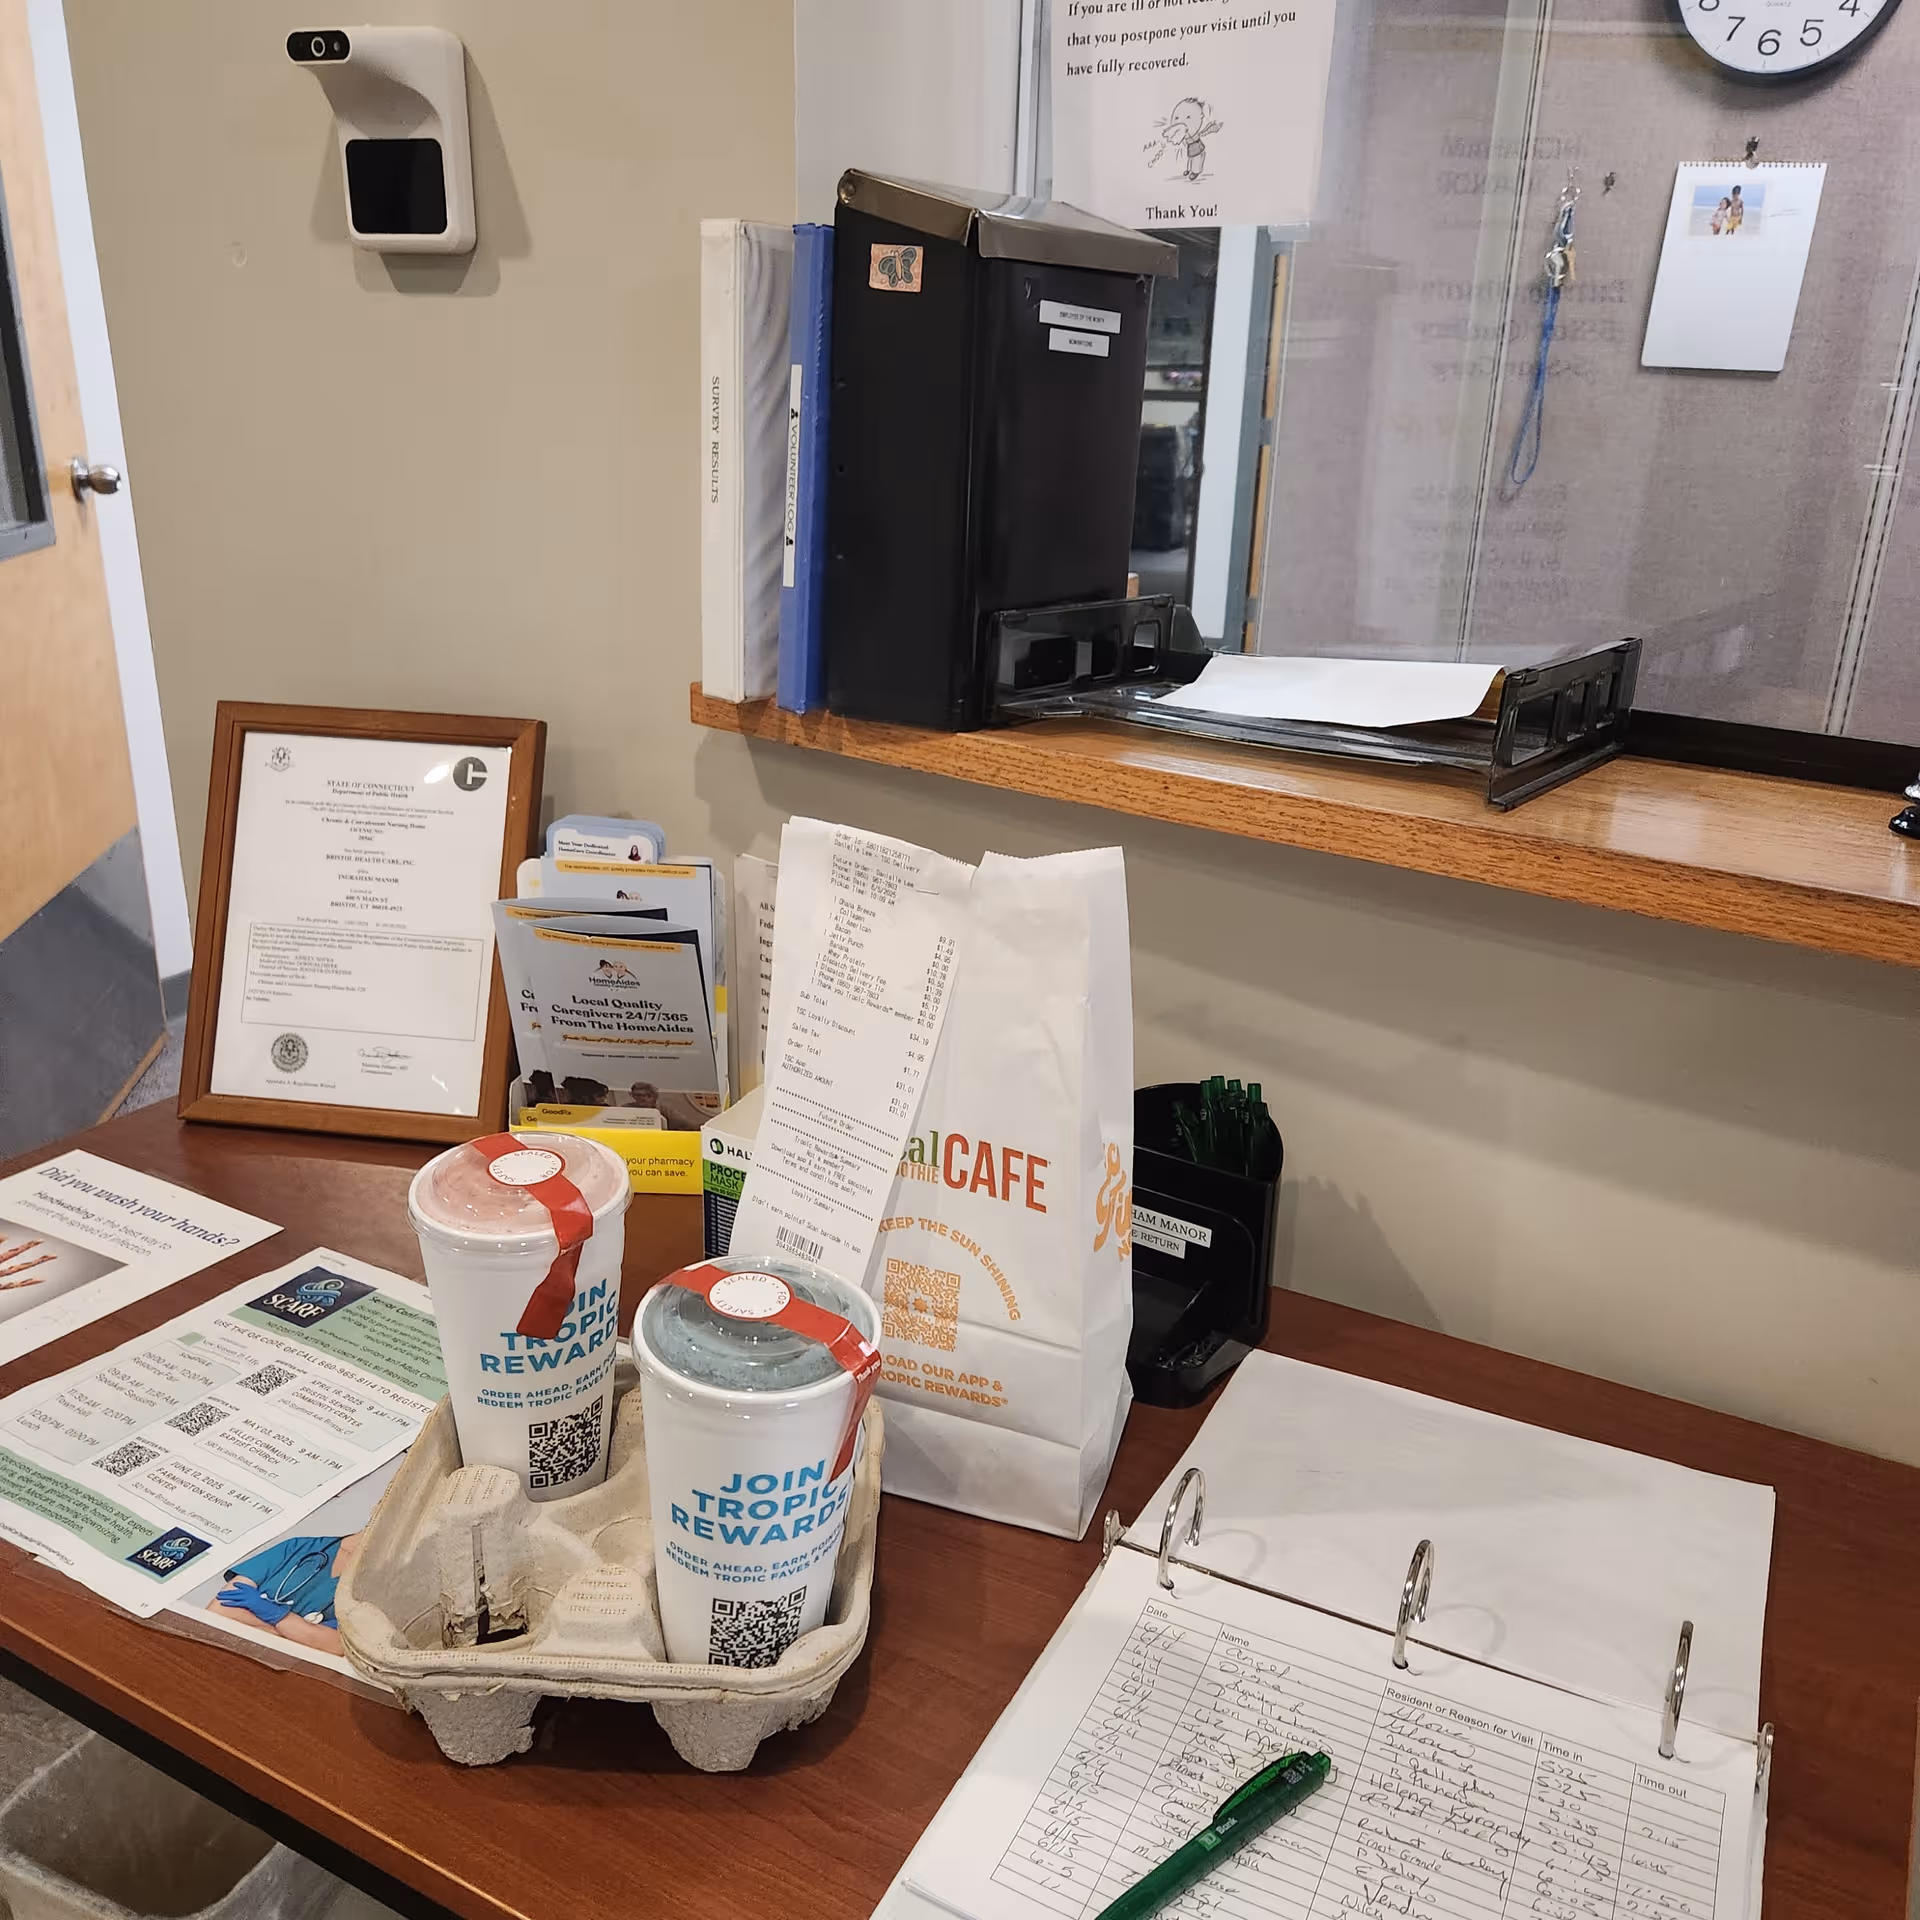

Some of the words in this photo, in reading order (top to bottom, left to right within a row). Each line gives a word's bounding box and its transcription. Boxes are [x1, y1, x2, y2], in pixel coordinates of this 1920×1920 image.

[1068, 2, 1078, 16] If
[1081, 2, 1103, 19] you
[1107, 3, 1127, 13] are
[1131, 0, 1144, 11] ill
[1148, 0, 1160, 9] or
[1838, 0, 1860, 17] 4
[1067, 33, 1091, 46] that
[1095, 33, 1117, 48] you
[1121, 27, 1177, 46] postpone
[1180, 23, 1208, 40] your
[1211, 18, 1237, 32] visit
[1242, 12, 1271, 29] until
[1273, 11, 1296, 27] you
[1726, 16, 1746, 42] 7
[1800, 19, 1824, 47] 5
[1757, 29, 1782, 56] 6
[1067, 63, 1093, 76] have
[1097, 59, 1124, 76] fully
[1128, 53, 1189, 72] recovered.
[1146, 206, 1186, 221] Thank
[1189, 204, 1218, 219] You!
[711, 376, 720, 434] SURVEY
[711, 441, 720, 504] RESULTS
[788, 424, 798, 500] VOLUNTEER
[787, 502, 796, 532] LOG
[327, 780, 349, 788] STATE
[363, 782, 415, 792] CONNECTICUT
[326, 854, 352, 862] BRISTOL
[355, 856, 381, 864] HEALTH
[834, 839, 860, 853] Danielle
[893, 860, 920, 873] Delivery
[832, 870, 851, 882] Pickup
[870, 883, 897, 898] 6/5/2025
[839, 898, 855, 910] Ohana
[857, 904, 876, 917] Breeze
[840, 907, 865, 922] Collagen
[939, 936, 956, 947] $9.91
[588, 977, 641, 987] HomeAides
[551, 1004, 623, 1020] Caregivers
[625, 1011, 689, 1022] 24/7/365
[572, 995, 608, 1006] Local
[611, 999, 663, 1011] Quality
[551, 1016, 587, 1028] From
[588, 1020, 614, 1030] The
[616, 1022, 694, 1033] HomeAides
[792, 1023, 808, 1033] Sales
[810, 1028, 821, 1038] Tax
[909, 1033, 930, 1046] $34.19
[781, 1062, 813, 1079] AUTHORIZED
[814, 1075, 834, 1087] AMOUNT
[895, 1081, 915, 1095] $31.01
[514, 1151, 552, 1159] SEALED
[626, 1158, 647, 1166] your
[648, 1157, 695, 1168] pharmacy
[727, 1145, 752, 1160] HAL
[710, 1174, 739, 1190] MASK
[943, 1133, 1048, 1214] CAFE
[37, 1166, 72, 1185] Did
[63, 1175, 98, 1194] you
[93, 1188, 139, 1210] wash
[133, 1203, 177, 1227] your
[172, 1218, 241, 1249] hands?
[1160, 1218, 1207, 1242] MANOR
[1140, 1232, 1180, 1251] RETURN
[723, 1274, 768, 1286] SEALED
[879, 1216, 915, 1233] KEEP
[918, 1218, 948, 1237] THE
[950, 1230, 982, 1258] SUN
[980, 1254, 1022, 1322] SHINING
[263, 1293, 325, 1319] SCARF
[715, 1300, 754, 1315] SAFETY
[776, 1291, 787, 1305] FOR
[480, 1315, 618, 1374] REWARD
[213, 1319, 231, 1331] USE
[233, 1322, 249, 1336] THE
[260, 1335, 285, 1350] CODE
[284, 1345, 298, 1355] OR
[296, 1348, 319, 1364] CALL
[317, 1359, 379, 1390] 860-965-8114
[378, 1383, 392, 1396] TO
[481, 1388, 521, 1399] ORDER
[526, 1383, 573, 1399] AHEAD,
[576, 1364, 601, 1385] EARN
[882, 1354, 918, 1372] OAD
[921, 1363, 955, 1380] OUR
[958, 1372, 990, 1390] APP
[992, 1380, 1003, 1392] &
[56, 1394, 78, 1409] Town
[76, 1406, 93, 1418] Hall
[292, 1391, 334, 1412] COMMUNITY
[334, 1410, 363, 1428] CENTER
[300, 1386, 329, 1401] BRISTOL
[328, 1398, 357, 1414] SENIOR
[477, 1396, 524, 1408] REDEEM
[528, 1392, 572, 1408] TROPIC
[16, 1416, 41, 1432] Lunch
[147, 1473, 177, 1492] CENTER
[156, 1467, 210, 1496] FARMINGTON
[203, 1492, 233, 1509] SENIOR
[720, 1459, 825, 1495] JOIN
[692, 1482, 838, 1521] TROPIC
[137, 1549, 178, 1570] SCARF
[666, 1547, 710, 1578] REDEEM
[713, 1572, 766, 1583] TROPIC
[770, 1559, 811, 1581] FAVES
[669, 1541, 708, 1567] ORDER
[712, 1562, 768, 1573] AHEAD,
[772, 1552, 808, 1570] EARN
[1146, 1605, 1169, 1619] Date
[1220, 1631, 1250, 1647] Name
[1387, 1687, 1433, 1711] Resident
[1435, 1704, 1446, 1714] or
[1448, 1708, 1490, 1731] Reason
[1492, 1723, 1508, 1736] for
[1510, 1729, 1534, 1746] Visit
[1543, 1741, 1571, 1758] Time
[1573, 1751, 1584, 1763] in
[1637, 1773, 1665, 1790] Time
[1668, 1785, 1688, 1798] out
[1216, 1817, 1238, 1835] Bank
